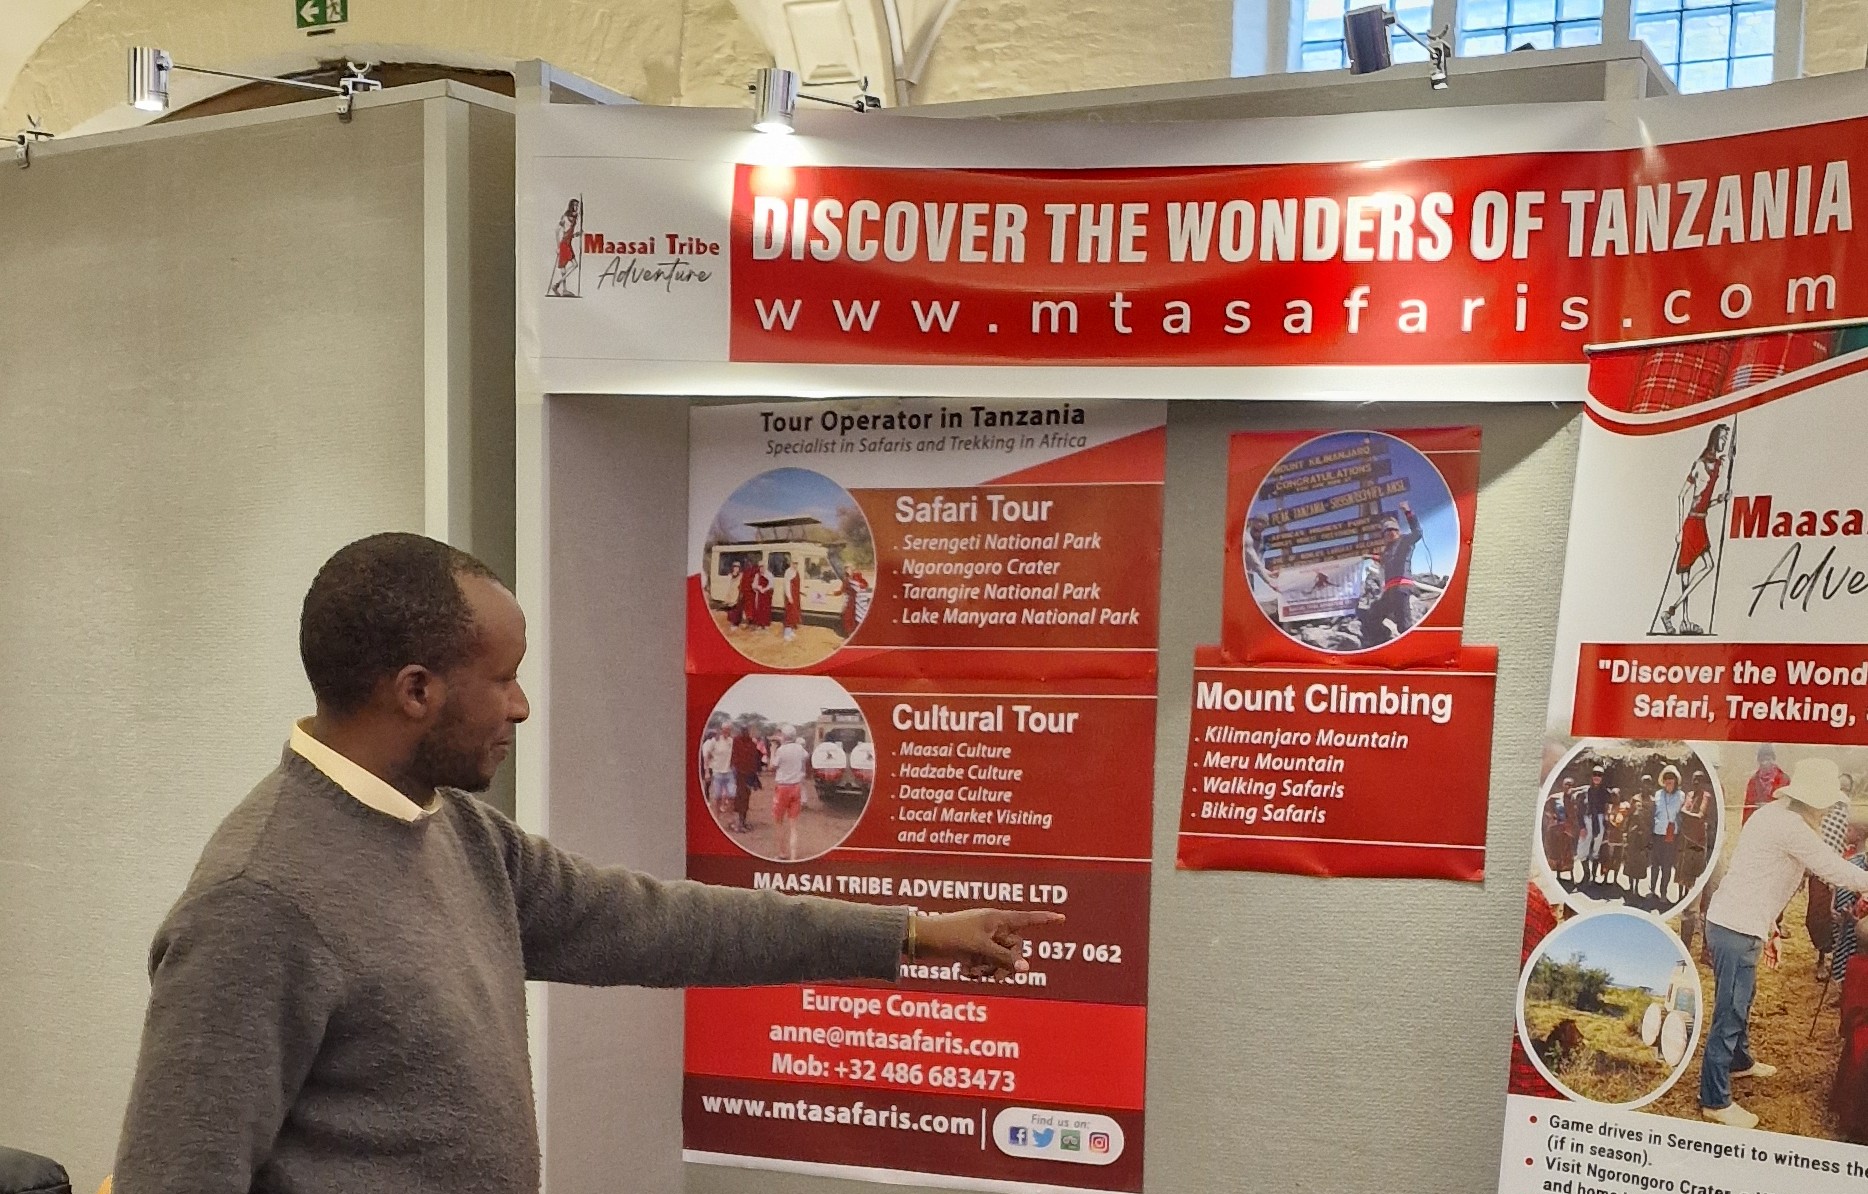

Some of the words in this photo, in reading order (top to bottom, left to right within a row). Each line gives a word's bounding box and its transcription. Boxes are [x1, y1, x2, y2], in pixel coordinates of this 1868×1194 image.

[751, 196, 1028, 263] DISCOVER
[1044, 202, 1149, 263] THE
[1166, 190, 1453, 263] WONDERS
[1470, 190, 1546, 261] OF
[1560, 160, 1853, 257] TANZANIA
[583, 233, 655, 256] Maasai
[665, 233, 720, 256] Tribe
[597, 254, 712, 293] Adventure
[761, 411, 812, 433] Tour
[821, 409, 932, 436] Operator
[941, 406, 962, 428] in
[971, 404, 1085, 428] Tanzania
[766, 438, 837, 456] Specialist
[840, 438, 854, 453] in
[859, 435, 912, 453] Safaris
[917, 436, 945, 452] and
[950, 434, 1015, 455] Trekking
[1019, 434, 1035, 449] in
[1039, 433, 1087, 449] Africa
[895, 495, 977, 522] Safari
[988, 495, 1053, 521] Tour
[1729, 495, 1868, 540] Maasa
[902, 533, 981, 553] Serengeti
[985, 533, 1058, 550] National
[1062, 532, 1101, 550] Park
[902, 560, 1002, 579] Ngorongoro
[1007, 559, 1060, 576] Crater
[1747, 541, 1868, 618] Adve
[902, 583, 981, 603] Tarangire
[985, 583, 1058, 601] National
[1062, 582, 1101, 601] Park
[902, 608, 938, 625] Lake
[943, 608, 1015, 629] Manyara
[1021, 608, 1095, 625] National
[1100, 607, 1139, 625] Park
[1598, 660, 1725, 685] "Discover
[1733, 661, 1776, 685] the
[1787, 661, 1868, 686] Wond
[1196, 682, 1296, 713] Mount
[1305, 684, 1453, 723] Climbing
[1633, 694, 1715, 722] Safari,
[1726, 695, 1856, 726] Trekking,
[892, 703, 1003, 732] Cultural
[1012, 705, 1079, 733] Tour
[1205, 726, 1311, 748] Kilimanjaro
[1316, 729, 1409, 749] Mountain
[900, 742, 953, 759] Maasai
[957, 743, 1011, 760] Culture
[1203, 751, 1249, 770] Meru
[1254, 753, 1345, 773] Mountain
[900, 764, 963, 781] Hadzabe
[968, 765, 1023, 782] Culture
[899, 786, 954, 804] Datoga
[958, 787, 1012, 803] Culture
[1202, 777, 1276, 798] Walking
[1281, 779, 1345, 799] Safaris
[899, 807, 937, 823] Local
[941, 808, 993, 825] Market
[997, 809, 1053, 829] Visiting
[1201, 802, 1256, 824] Biking
[1262, 804, 1326, 823] Safaris
[897, 829, 925, 844] and
[929, 829, 969, 845] other
[973, 833, 1011, 846] more
[753, 871, 832, 893] MAASAI
[836, 874, 893, 896] TRIBE
[898, 878, 1024, 902] ADVENTURE
[1029, 884, 1067, 904] LTD
[1038, 941, 1076, 960] 037
[1083, 944, 1122, 963] 062
[802, 989, 882, 1019] Europe
[886, 994, 987, 1022] Contacts
[770, 1022, 1019, 1059] anne@mtasafaris.com
[771, 1054, 830, 1078] Mob:
[833, 1058, 876, 1082] +32
[881, 1061, 923, 1085] 486
[928, 1065, 1016, 1093] 683473
[702, 1093, 974, 1136] www.mtasafaris.com
[1031, 1114, 1053, 1126] Find
[1547, 1135, 1566, 1154] (if
[1570, 1138, 1585, 1154] in
[1590, 1144, 1653, 1167] season).
[1549, 1115, 1593, 1135] Game
[1598, 1121, 1643, 1142] drives
[1648, 1129, 1662, 1145] in
[1667, 1134, 1745, 1159] Serengeti
[1751, 1145, 1768, 1162] to
[1774, 1151, 1840, 1174] witness
[1546, 1156, 1582, 1176] Visit
[1587, 1163, 1674, 1193] Ngorongoro
